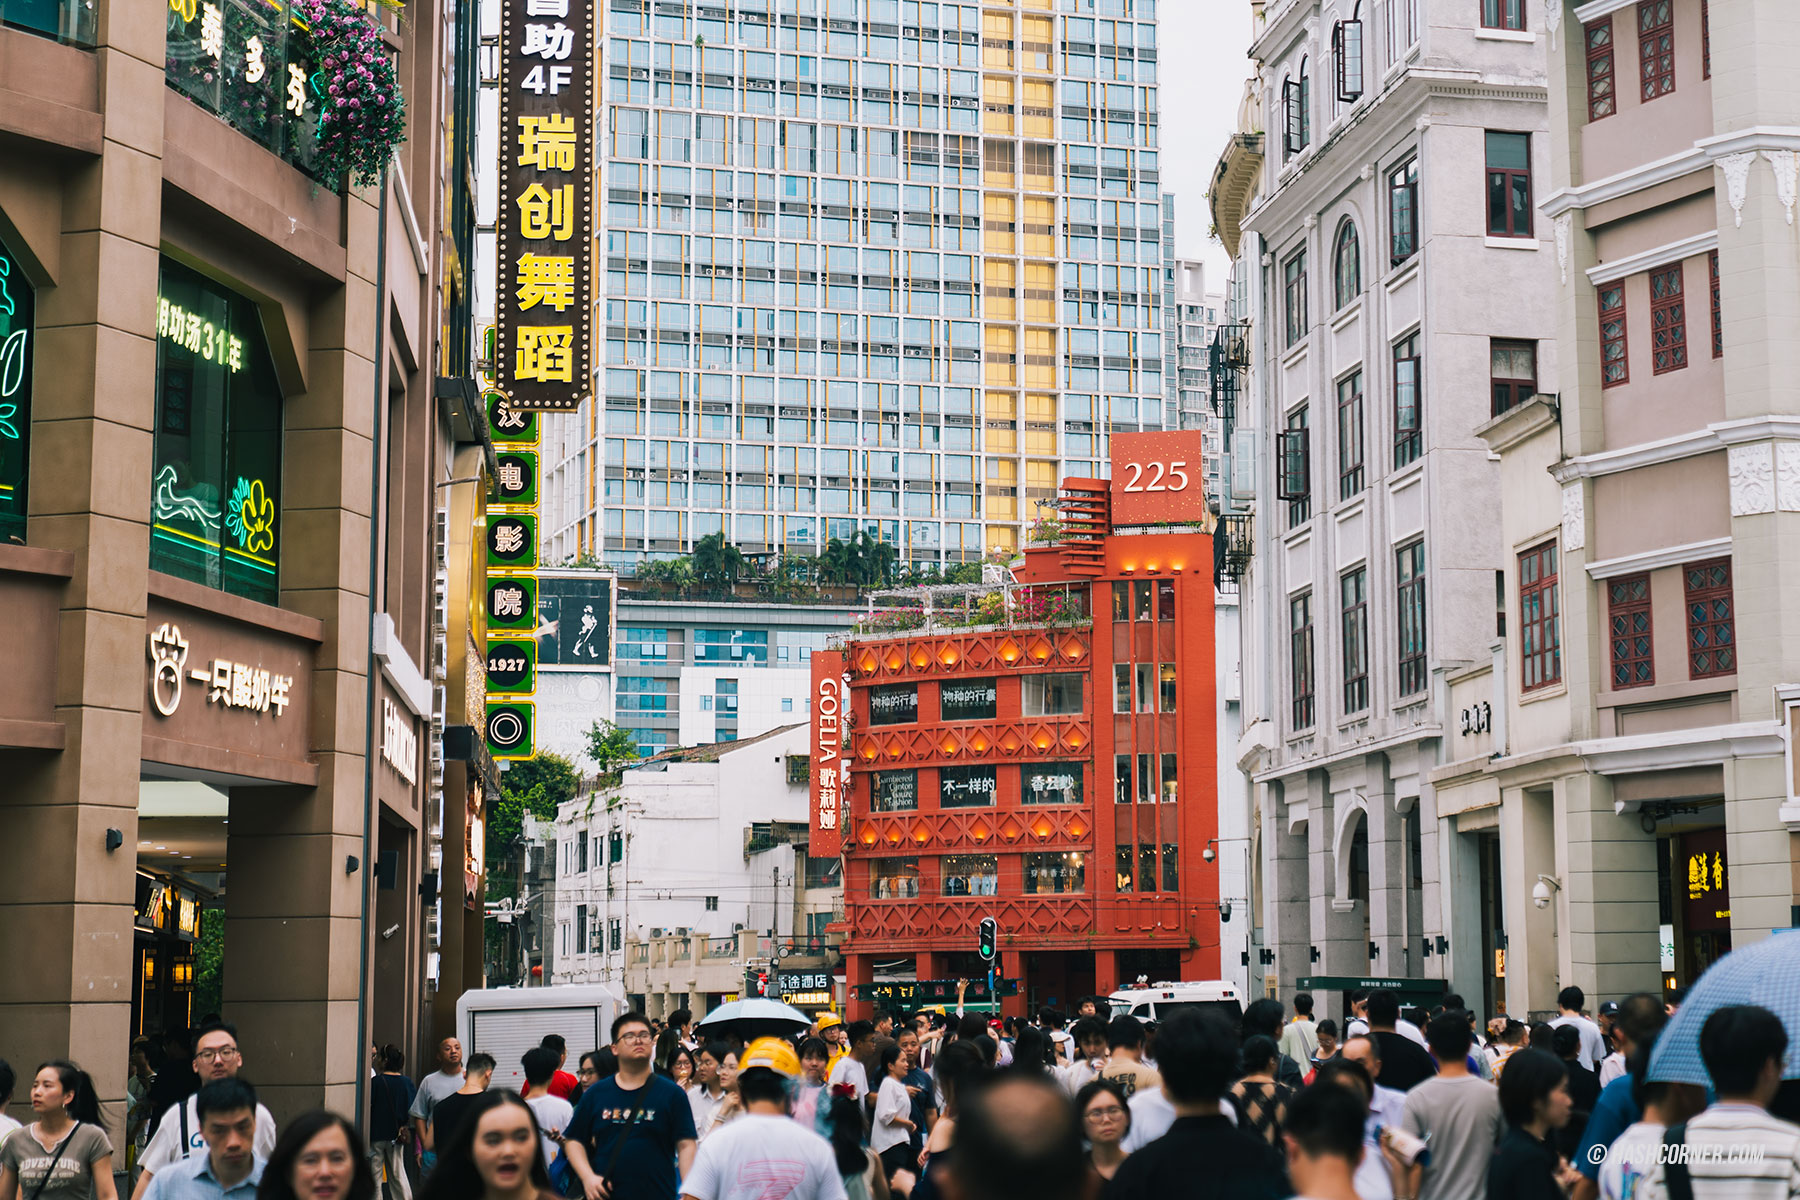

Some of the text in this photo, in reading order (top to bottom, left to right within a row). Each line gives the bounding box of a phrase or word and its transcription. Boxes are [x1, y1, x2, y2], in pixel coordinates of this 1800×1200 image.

[521, 65, 573, 95] 4F
[514, 113, 577, 383] 瑞创舞蹈
[1124, 461, 1189, 493] 225
[494, 401, 525, 616] 汉电影院
[190, 657, 293, 717] 一只酸奶牛
[489, 658, 526, 673] 1927
[818, 678, 838, 830] GOELIA 歌莉娅
[942, 777, 996, 796] 不一样的
